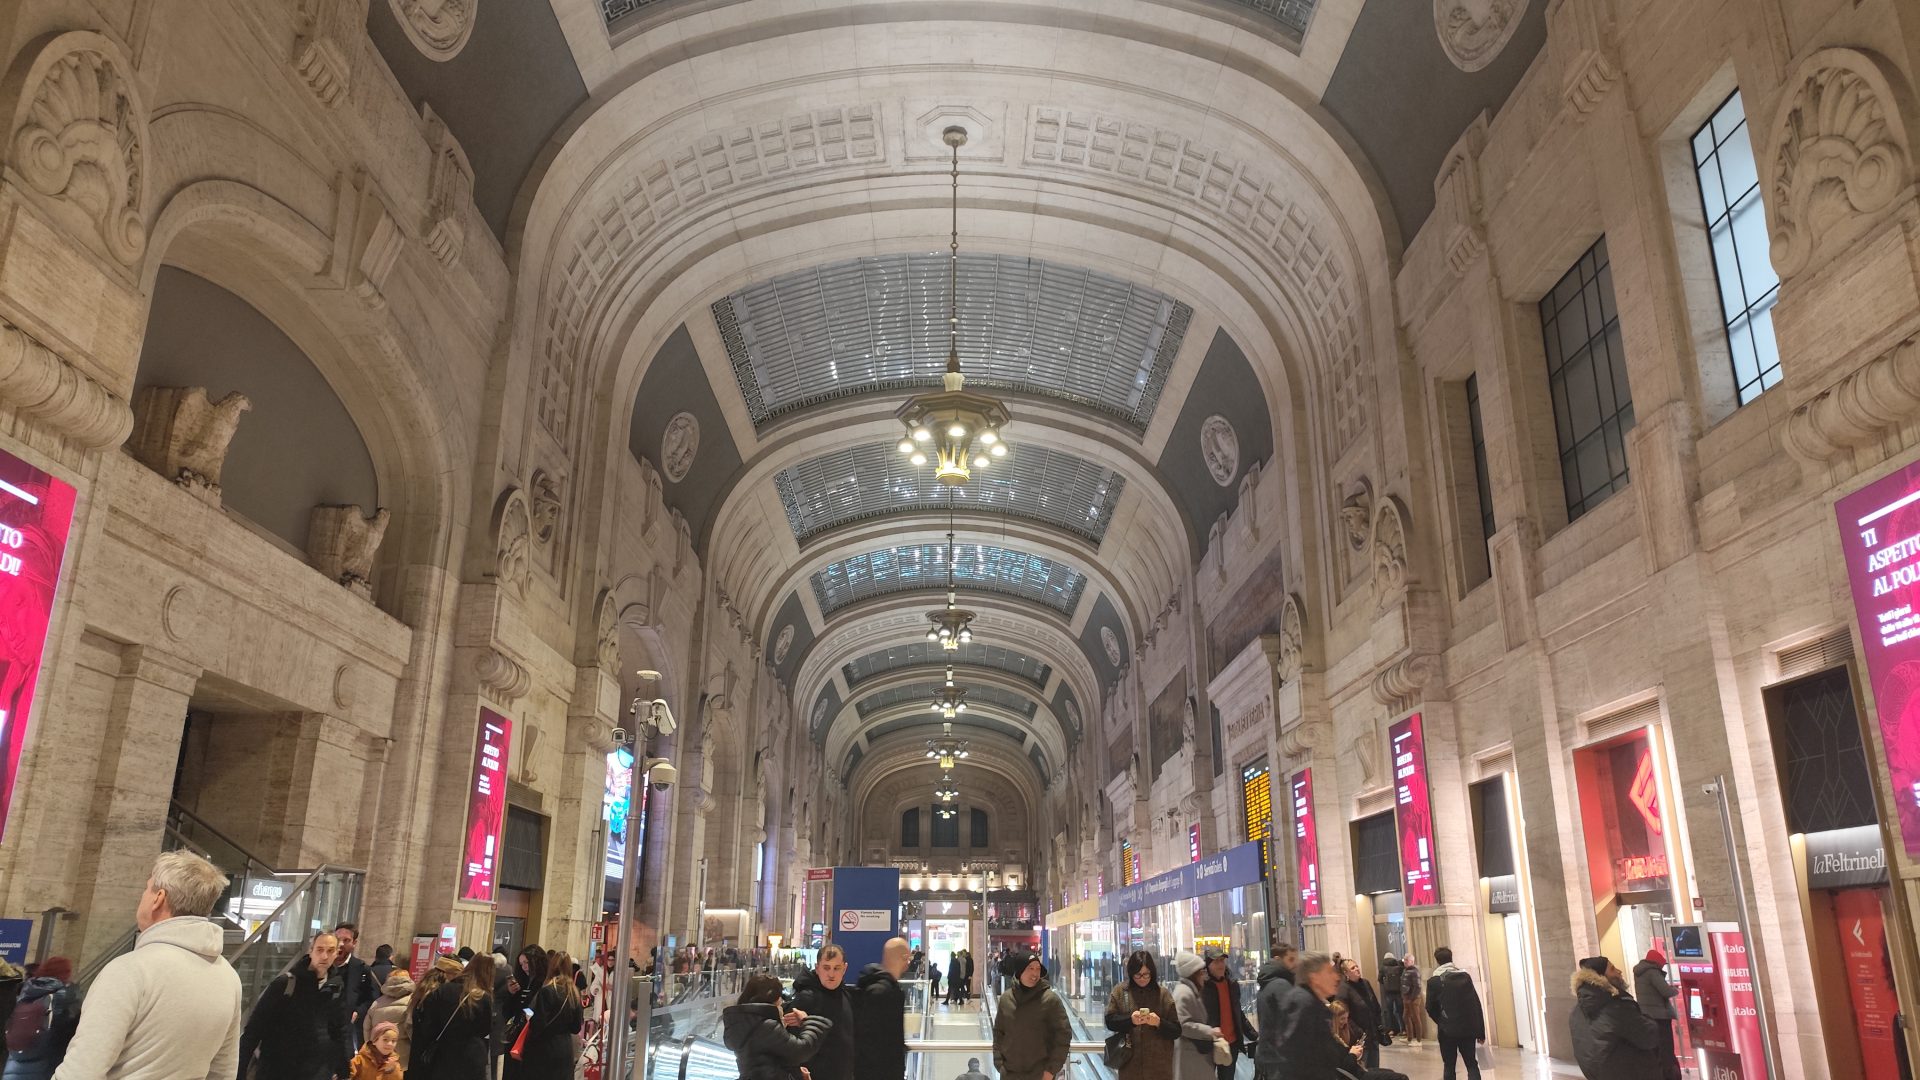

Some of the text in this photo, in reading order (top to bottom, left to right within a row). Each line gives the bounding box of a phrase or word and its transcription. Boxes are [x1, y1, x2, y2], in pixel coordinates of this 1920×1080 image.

[1861, 528, 1878, 548] TI
[1873, 561, 1920, 597] AL POL
[1813, 848, 1888, 874] laFeltrinell
